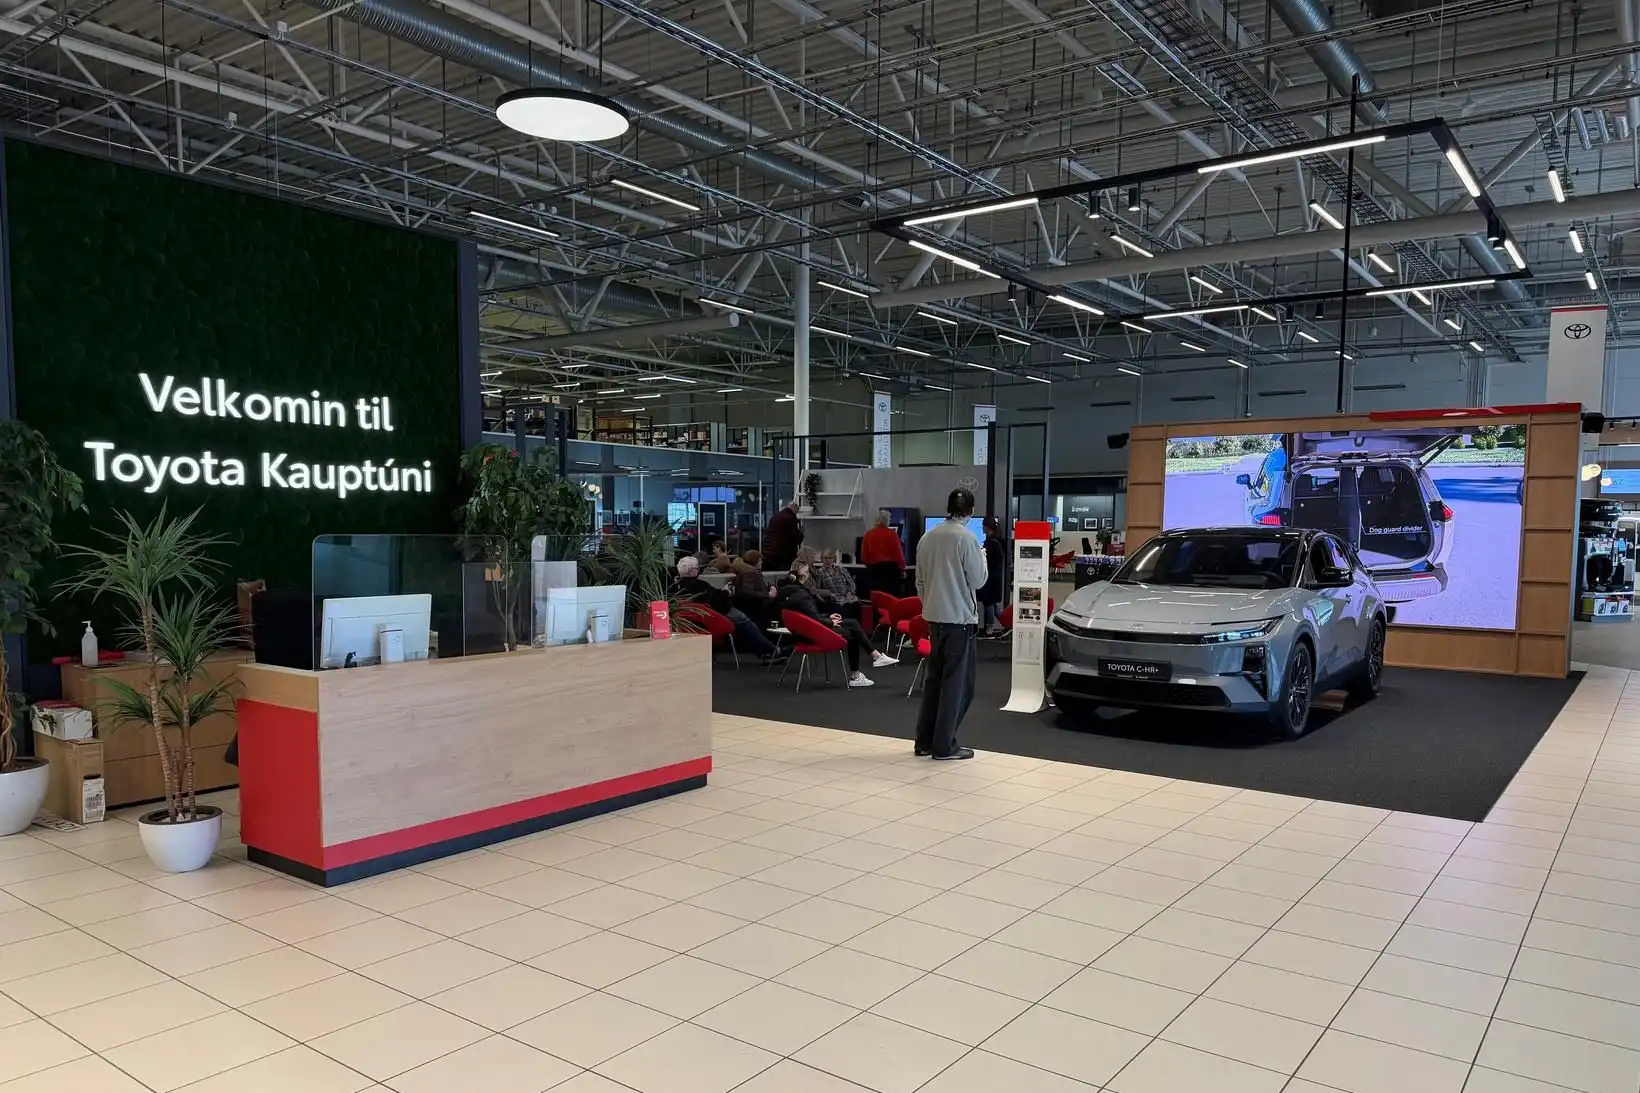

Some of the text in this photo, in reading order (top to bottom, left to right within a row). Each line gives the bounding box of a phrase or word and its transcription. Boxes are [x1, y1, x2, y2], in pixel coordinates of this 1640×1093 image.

[139, 372, 394, 432] Velkomin til
[84, 442, 433, 498] Toyota Kauptúni
[1369, 526, 1382, 534] Dog
[1383, 526, 1402, 534] guard
[1107, 663, 1159, 673] TOYOTA C-HR+
